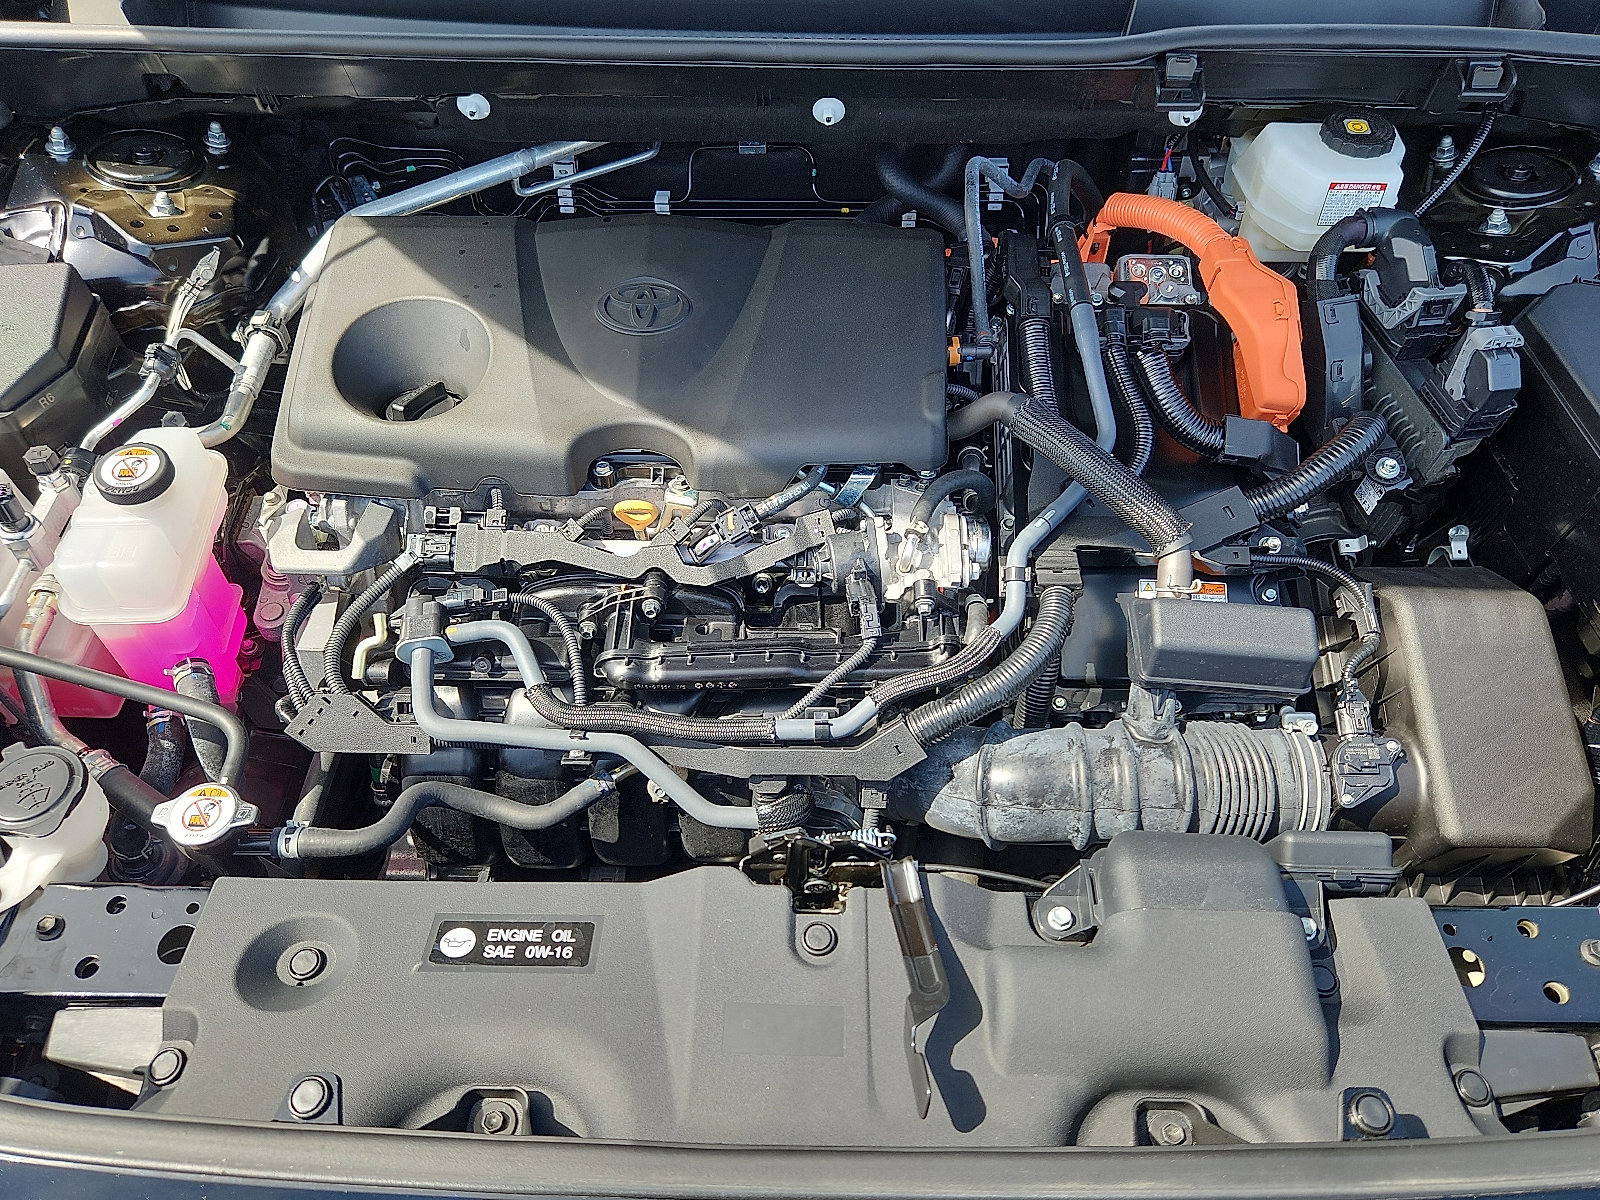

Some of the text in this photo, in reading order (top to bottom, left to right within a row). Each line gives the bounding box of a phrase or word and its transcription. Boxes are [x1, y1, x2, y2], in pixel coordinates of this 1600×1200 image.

[38, 392, 55, 409] R6
[486, 928, 577, 943] ENGINE OIL
[482, 945, 574, 959] SAE 0W-16
